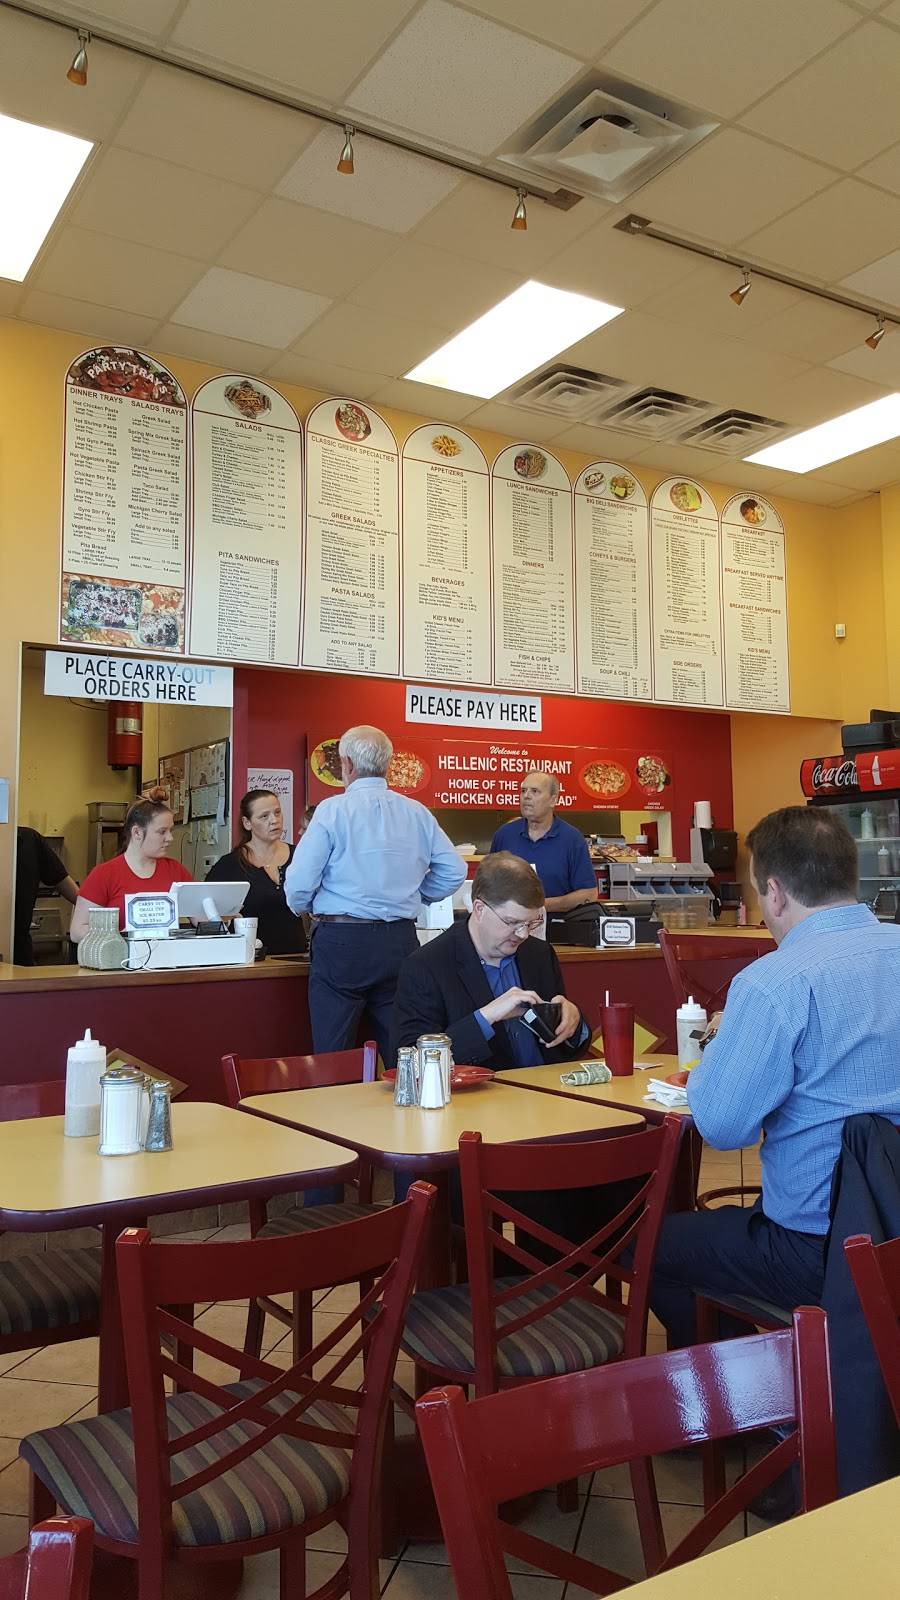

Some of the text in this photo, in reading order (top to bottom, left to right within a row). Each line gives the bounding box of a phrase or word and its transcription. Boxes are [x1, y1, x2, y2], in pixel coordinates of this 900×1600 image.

[88, 361, 167, 394] PARTY TRAYS
[70, 388, 123, 404] DINNER TRAYS
[83, 402, 103, 411] Chicken
[105, 406, 119, 414] Pasta
[131, 401, 184, 416] SALADS TRAYS
[84, 420, 102, 428] Shrimp
[235, 421, 262, 432] SALADS
[128, 429, 144, 437] Spring
[311, 436, 395, 462] CLASSIC GREEK SPECIALTIES
[81, 454, 104, 463] Vegetable
[431, 466, 464, 477] APPETIZERS
[76, 488, 93, 496] Shrimp
[525, 485, 558, 496] SANDWICHES
[128, 504, 150, 512] Michigan
[607, 502, 637, 512] SANDWICHES
[331, 512, 376, 526] GREEK SALADS
[72, 523, 96, 531] Vegetable
[741, 528, 765, 536] BREAKFAST
[219, 551, 279, 566] PITA SANDWICHES
[522, 560, 544, 568] DINNERS
[725, 567, 749, 576] BREAKFAST
[432, 577, 464, 586] BEVERAGES
[331, 587, 375, 599] PASTA SALADS
[730, 603, 781, 614] BREAKFAST SANDWICHES
[65, 657, 215, 685] PLACE CARRY-OUT
[84, 678, 197, 701] ORDERS HERE
[411, 695, 537, 722] PLEASE PAY HERE
[489, 746, 528, 755] Welcome to
[438, 755, 572, 774] HELLENIC RESTAURANT
[812, 760, 858, 787] Coca-Cola
[449, 779, 479, 789] HOME
[482, 780, 496, 790] OF
[499, 781, 518, 791] THE
[435, 792, 493, 805] “CHICKEN
